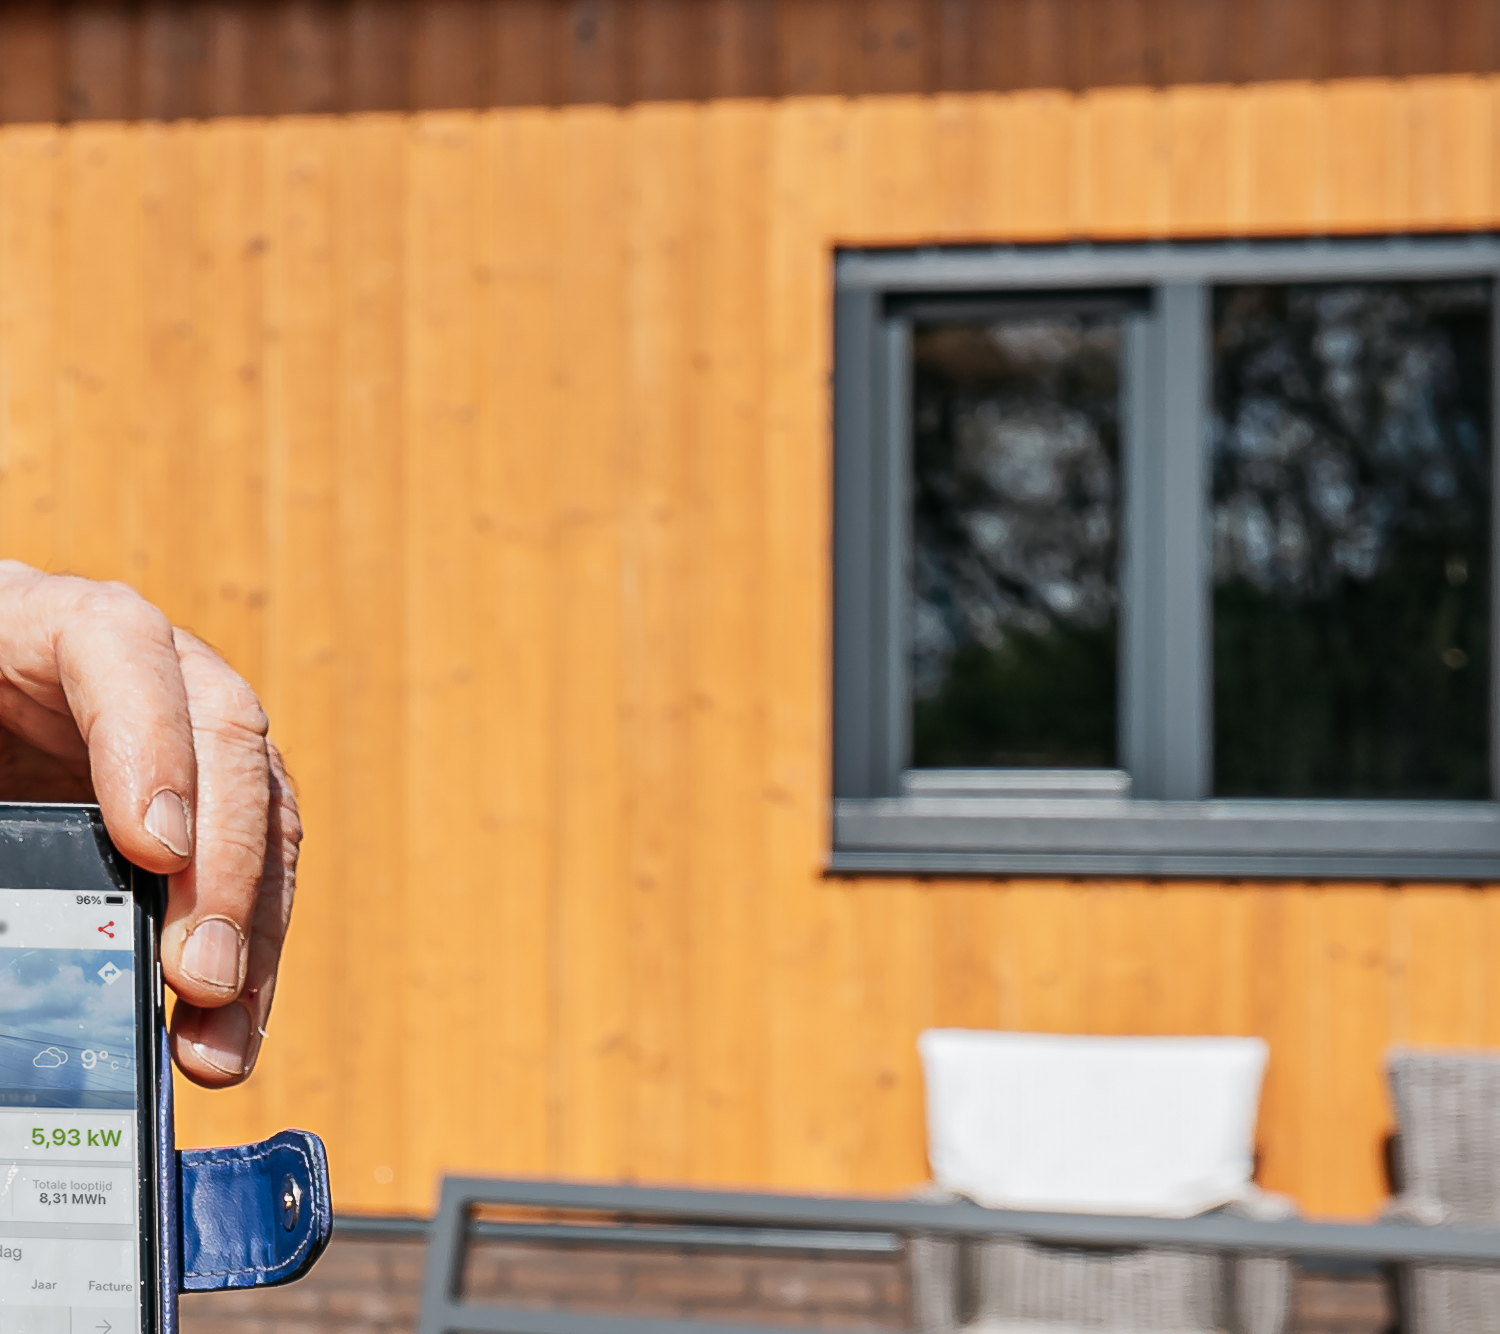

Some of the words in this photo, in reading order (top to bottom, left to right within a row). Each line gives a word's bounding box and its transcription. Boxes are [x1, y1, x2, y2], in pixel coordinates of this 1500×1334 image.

[75, 895, 102, 905] 96%
[31, 1127, 81, 1149] 5,93
[87, 1128, 123, 1147] kW
[32, 1179, 68, 1191] Totale
[70, 1180, 113, 1195] looptijd
[39, 1192, 68, 1206] 8,31
[71, 1193, 107, 1205] MWh
[31, 1278, 58, 1290] Jaar
[88, 1280, 133, 1293] Facture
